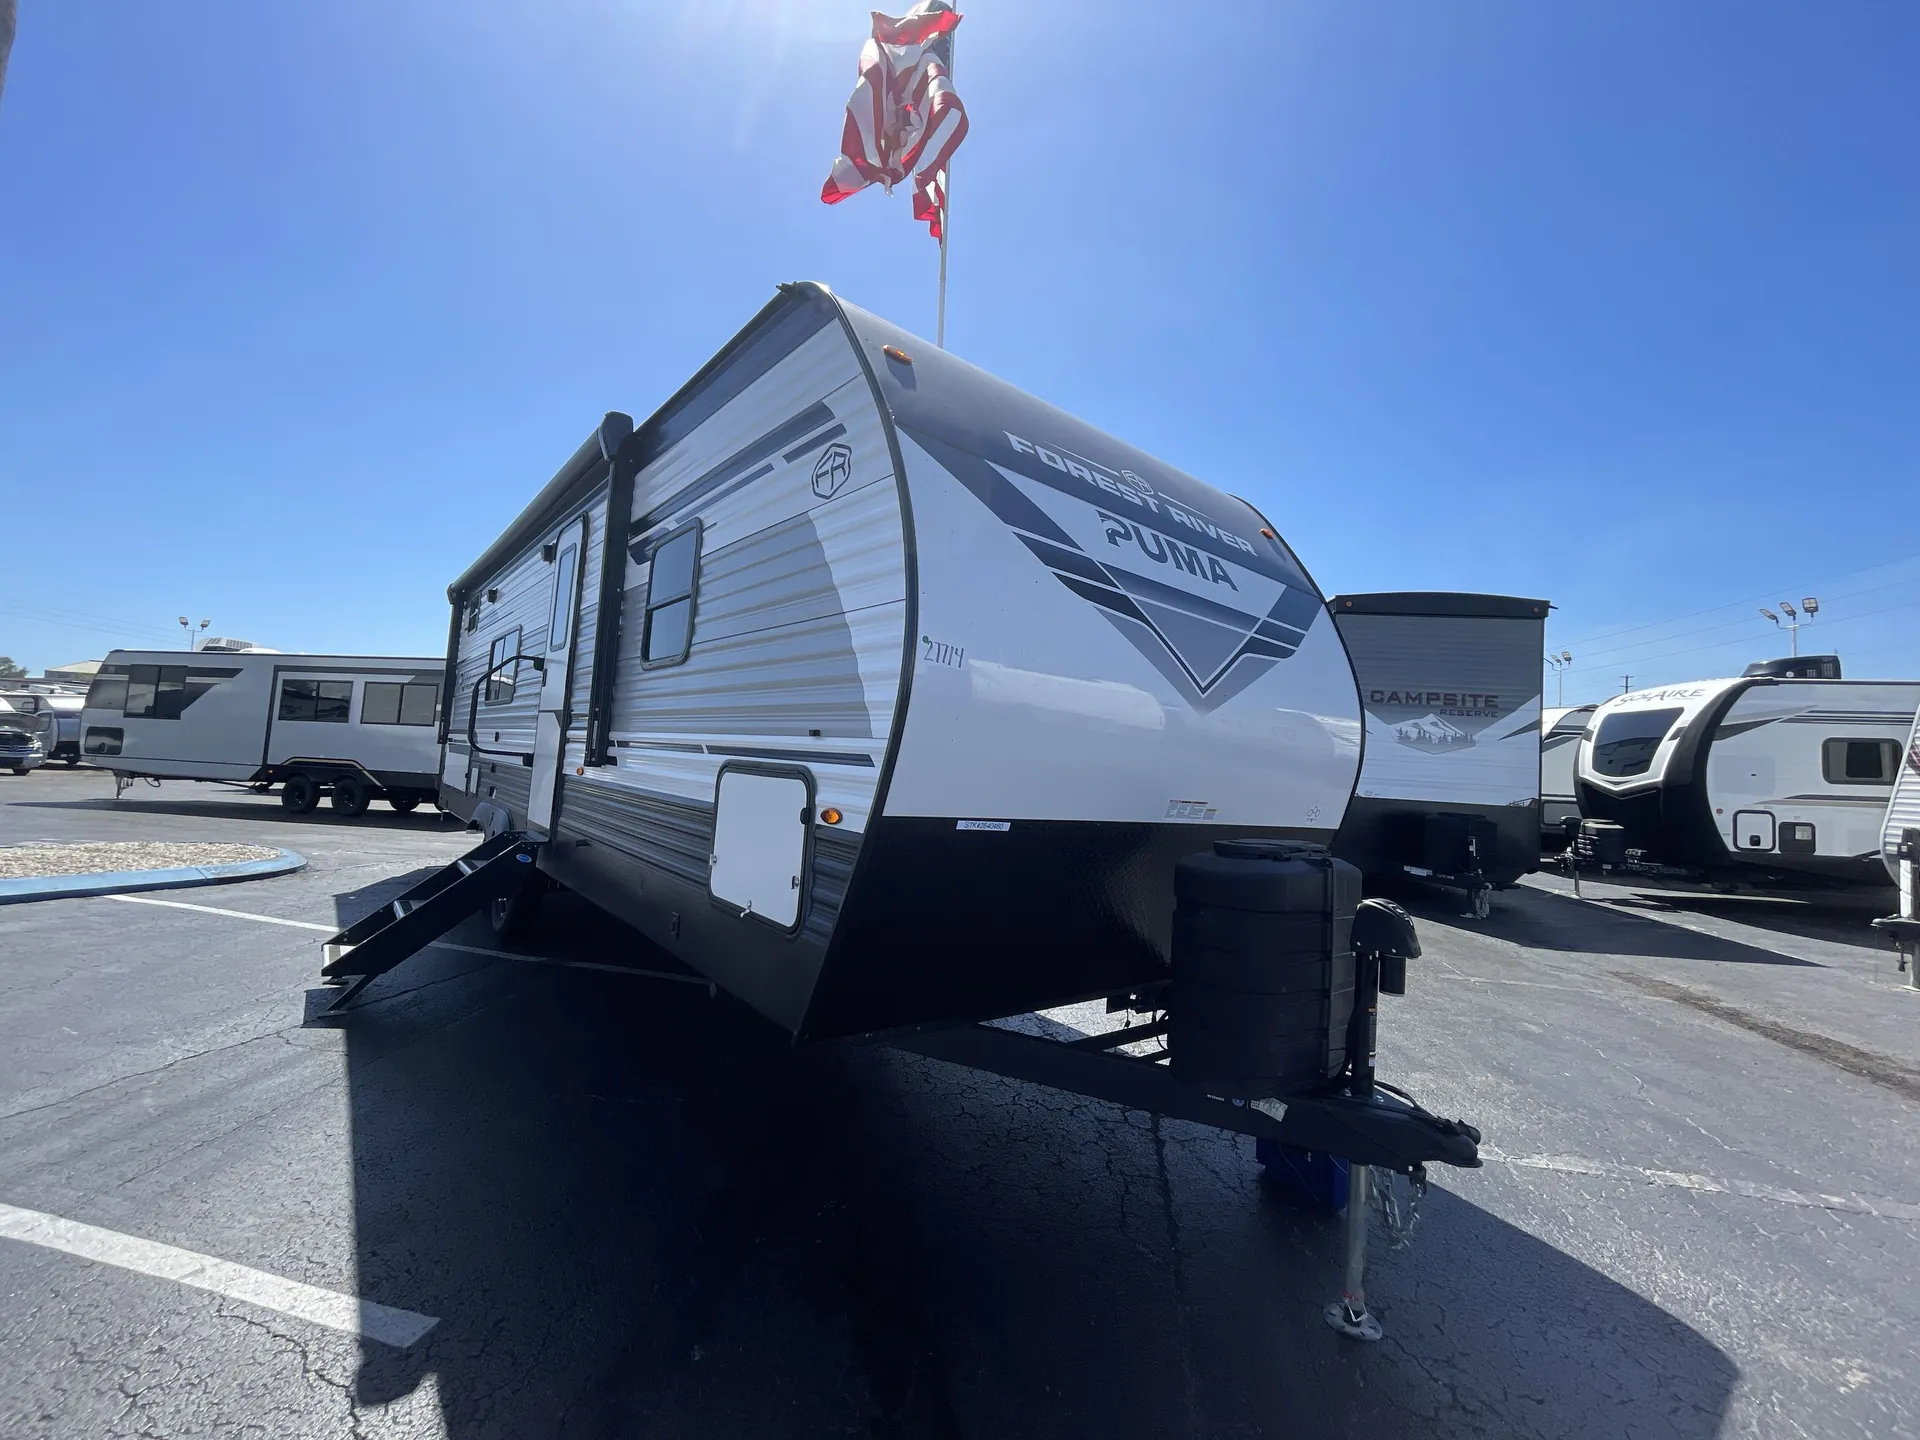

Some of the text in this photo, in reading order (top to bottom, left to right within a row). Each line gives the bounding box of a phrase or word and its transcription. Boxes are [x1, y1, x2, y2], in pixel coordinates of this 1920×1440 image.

[1002, 430, 1258, 557] FOREST RIVER
[1096, 509, 1239, 592] PUMA
[924, 640, 964, 669] 27714
[1370, 690, 1500, 709] CAMPSITE
[1613, 688, 1706, 707] SOLAIRE
[1440, 708, 1499, 718] RESERVE
